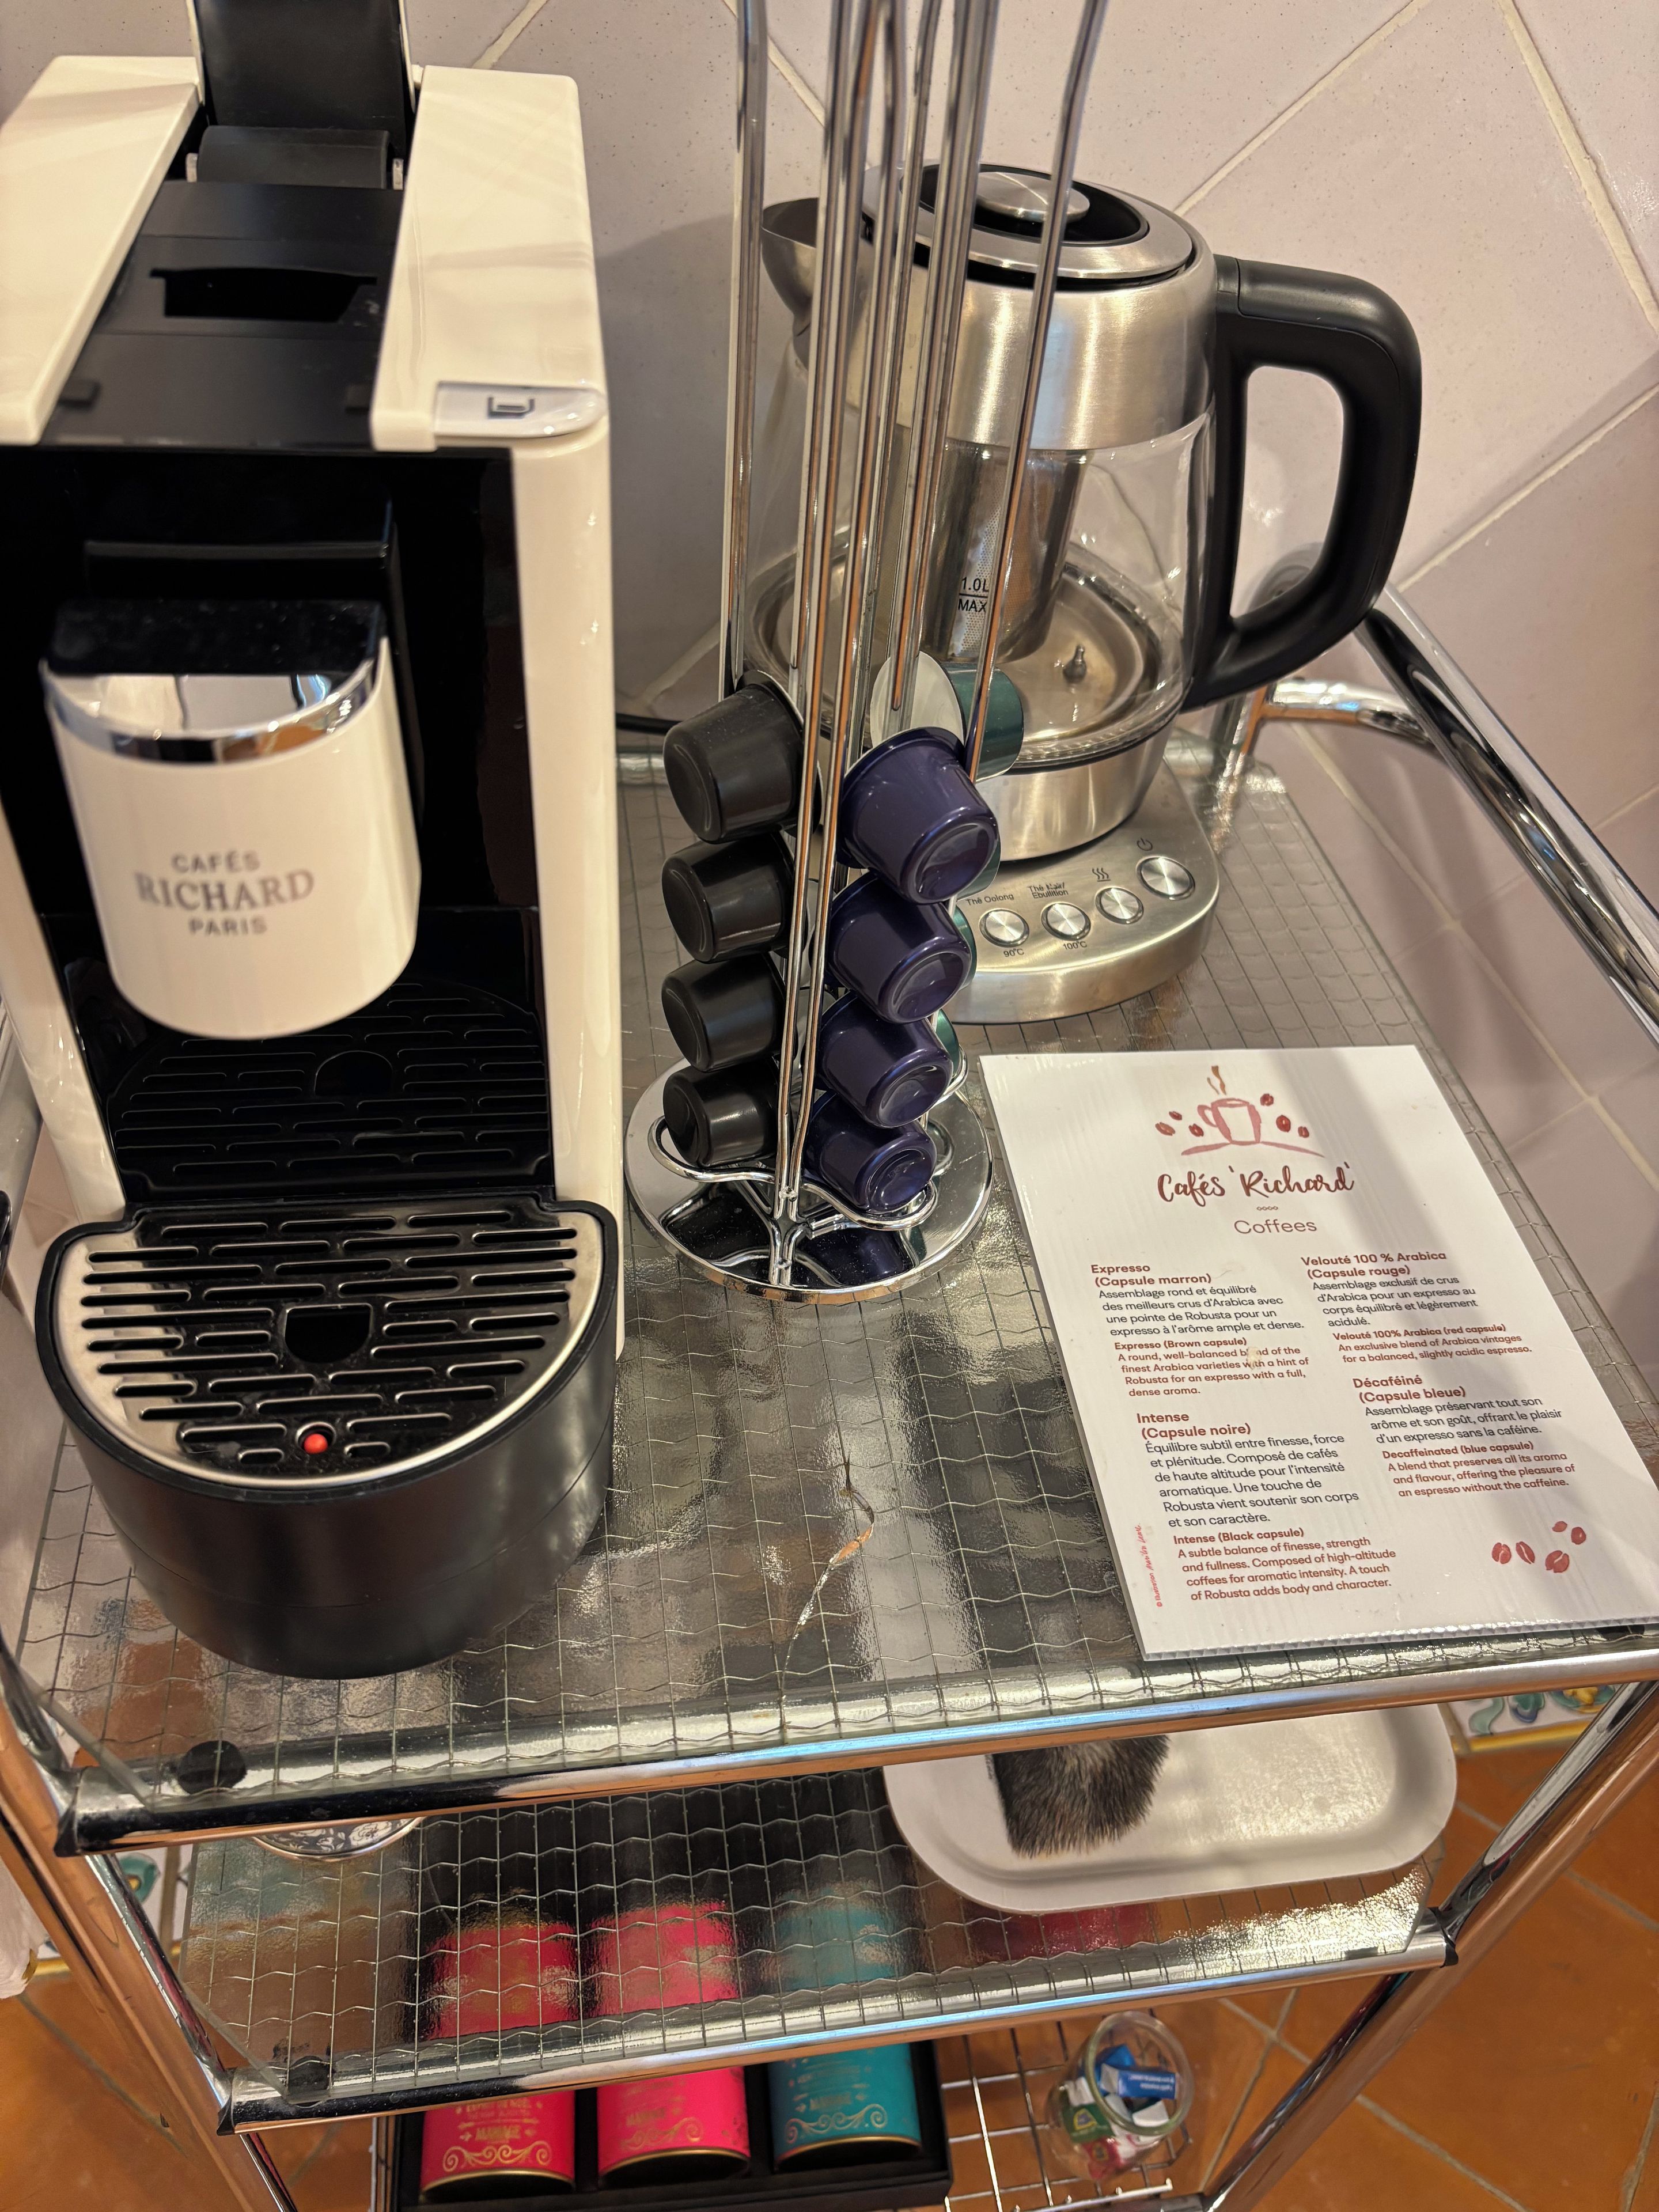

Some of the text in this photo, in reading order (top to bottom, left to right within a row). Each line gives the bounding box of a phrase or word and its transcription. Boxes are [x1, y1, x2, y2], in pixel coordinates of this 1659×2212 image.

[961, 577, 989, 592] 1.0L
[958, 599, 987, 613] MAX
[171, 849, 260, 873] CAFÉS
[134, 868, 315, 911] RICHARD
[984, 893, 1014, 903] Oolong
[189, 914, 268, 936] PARIS
[1003, 948, 1024, 957] 90°C
[1063, 941, 1088, 950] 100°C
[1158, 1171, 1226, 1207] Cafés
[1234, 1219, 1317, 1234] Coffees
[1301, 1251, 1447, 1266] Velouté 100 % Arabica
[1091, 1264, 1150, 1275] Expresso
[1307, 1264, 1410, 1280] (Capsule rouge)
[1095, 1273, 1211, 1288] (Capsule marron)
[1313, 1281, 1377, 1290] Assemblage
[1379, 1277, 1418, 1287] exclusif
[1420, 1277, 1434, 1285] de
[1099, 1289, 1165, 1299] Assemblage
[1167, 1287, 1194, 1296] rond
[1209, 1285, 1256, 1296] équilibré
[1317, 1293, 1368, 1302] d'Arabica
[1369, 1293, 1394, 1302] pour
[1413, 1289, 1460, 1299] expresso
[1103, 1302, 1123, 1310] des
[1125, 1301, 1175, 1310] meilleurs
[1203, 1298, 1255, 1307] d'Arabica
[1323, 1307, 1354, 1316] corps
[1355, 1302, 1403, 1315] équilibré
[1416, 1300, 1478, 1311] légèrement
[1130, 1314, 1166, 1325] pointe
[1168, 1312, 1183, 1321] de
[1184, 1311, 1232, 1320] Robusta
[1233, 1311, 1259, 1321] pour
[1328, 1317, 1370, 1327] acidulé.
[1110, 1328, 1160, 1338] expresso
[1162, 1325, 1171, 1334] à
[1171, 1324, 1214, 1334] l'arôme
[1216, 1322, 1251, 1334] ample
[1267, 1321, 1304, 1330] dense.
[1332, 1324, 1506, 1340] Velouté 100% Arabica (red capsule)
[1114, 1337, 1247, 1351] Expresso (Brown capsule)
[1125, 1376, 1169, 1385] Robusta
[1204, 1374, 1251, 1382] expresso
[1252, 1371, 1275, 1379] with
[1286, 1369, 1306, 1378] full,
[1353, 1374, 1423, 1388] Décaféiné
[1129, 1388, 1161, 1396] dense
[1359, 1386, 1466, 1404] (Capsule bleue)
[1366, 1404, 1433, 1416] Assemblage
[1434, 1400, 1496, 1414] préservant
[1495, 1399, 1521, 1408] tout
[1137, 1413, 1189, 1423] Intense
[1370, 1420, 1407, 1430] arôme
[1410, 1419, 1423, 1427] et
[1446, 1415, 1476, 1427] goût,
[1477, 1412, 1517, 1423] offrant
[1515, 1411, 1528, 1420] le
[1529, 1409, 1562, 1422] plaisir
[1142, 1423, 1251, 1440] (Capsule noire)
[1376, 1425, 1542, 1444] d'un expresso sans la caféine.
[1145, 1434, 1344, 1455] Équilibre subtil entre finesse, force
[1382, 1441, 1533, 1459] Decaffeinated (blue capsule)
[1150, 1448, 1338, 1469] et plénitude. Composé de cafés
[1155, 1462, 1345, 1482] de haute altitude pour l'intensité
[1159, 1478, 1322, 1497] aromatique. Une touche de
[1414, 1487, 1460, 1497] espresso
[1461, 1483, 1503, 1492] without
[1503, 1481, 1521, 1489] the
[1523, 1478, 1569, 1488] caffeine.
[1163, 1493, 1359, 1512] Robusta vient soutenir son corps
[1168, 1513, 1271, 1527] et son caractère.
[1173, 1527, 1304, 1544] Intense (Black capsule)
[1178, 1537, 1371, 1558] A subtle balance of finesse, strength
[1182, 1549, 1396, 1572] and fullness. Composed of high-altitude
[1149, 1572, 1161, 1601] Illustration
